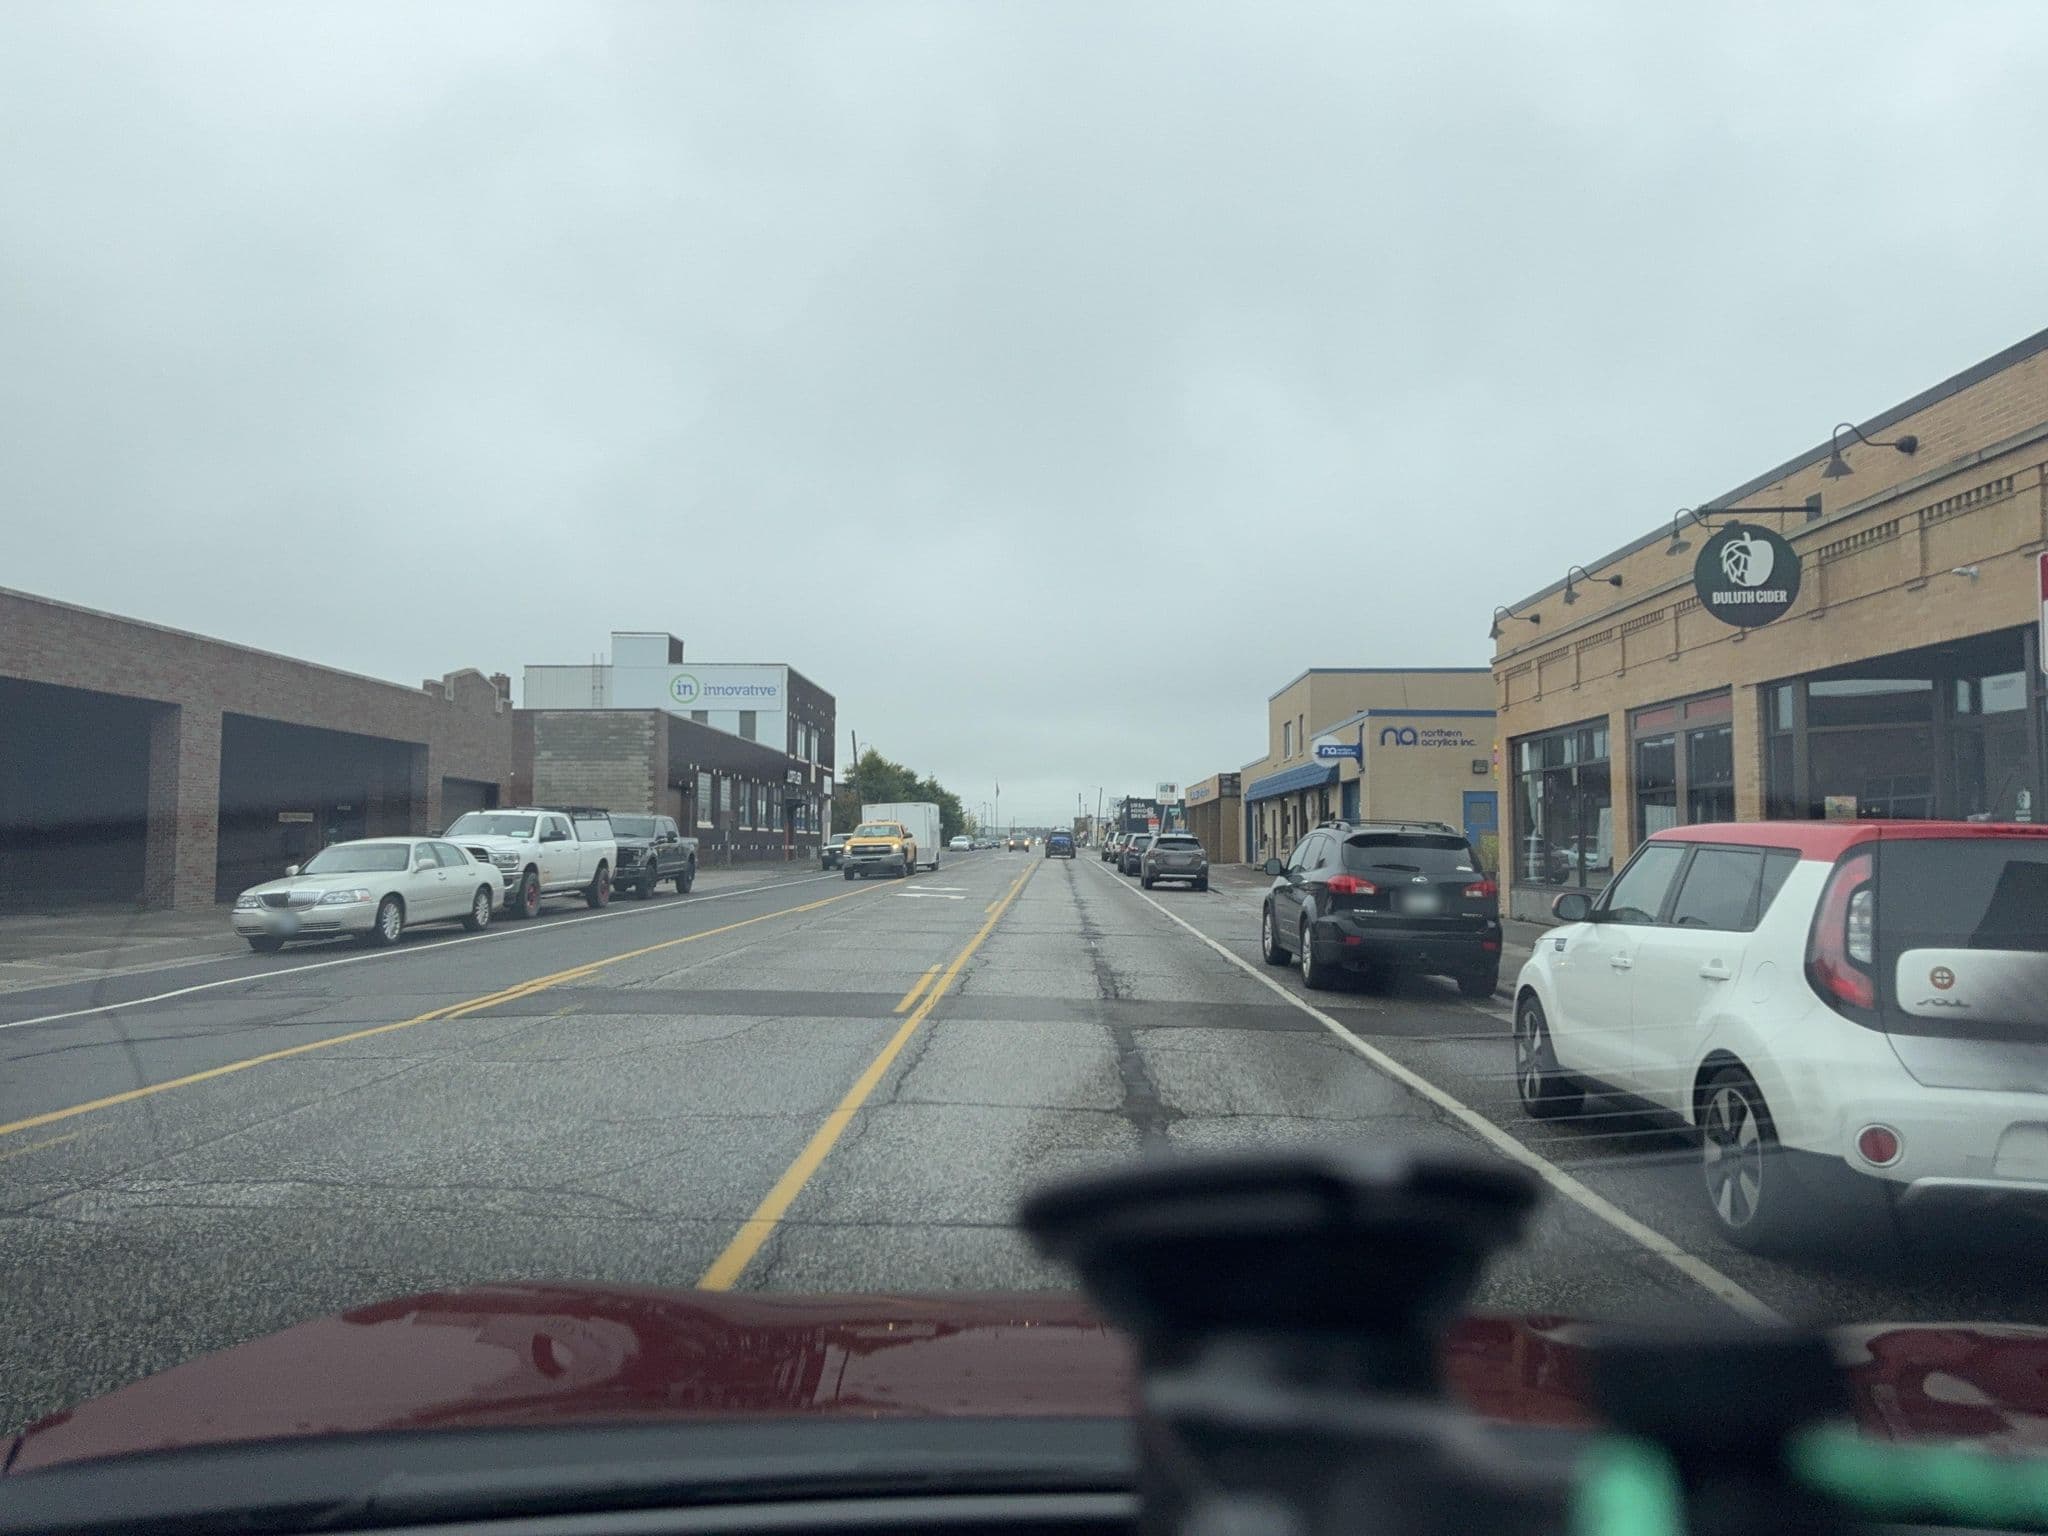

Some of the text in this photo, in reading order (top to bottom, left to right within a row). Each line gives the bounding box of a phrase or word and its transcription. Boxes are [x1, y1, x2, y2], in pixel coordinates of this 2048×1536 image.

[1712, 590, 1787, 604] DULUTH CIDER
[676, 680, 694, 696] in
[704, 683, 776, 696] innovative
[1381, 727, 1417, 746] na
[1421, 729, 1462, 737] northern
[1421, 738, 1457, 747] acrylics
